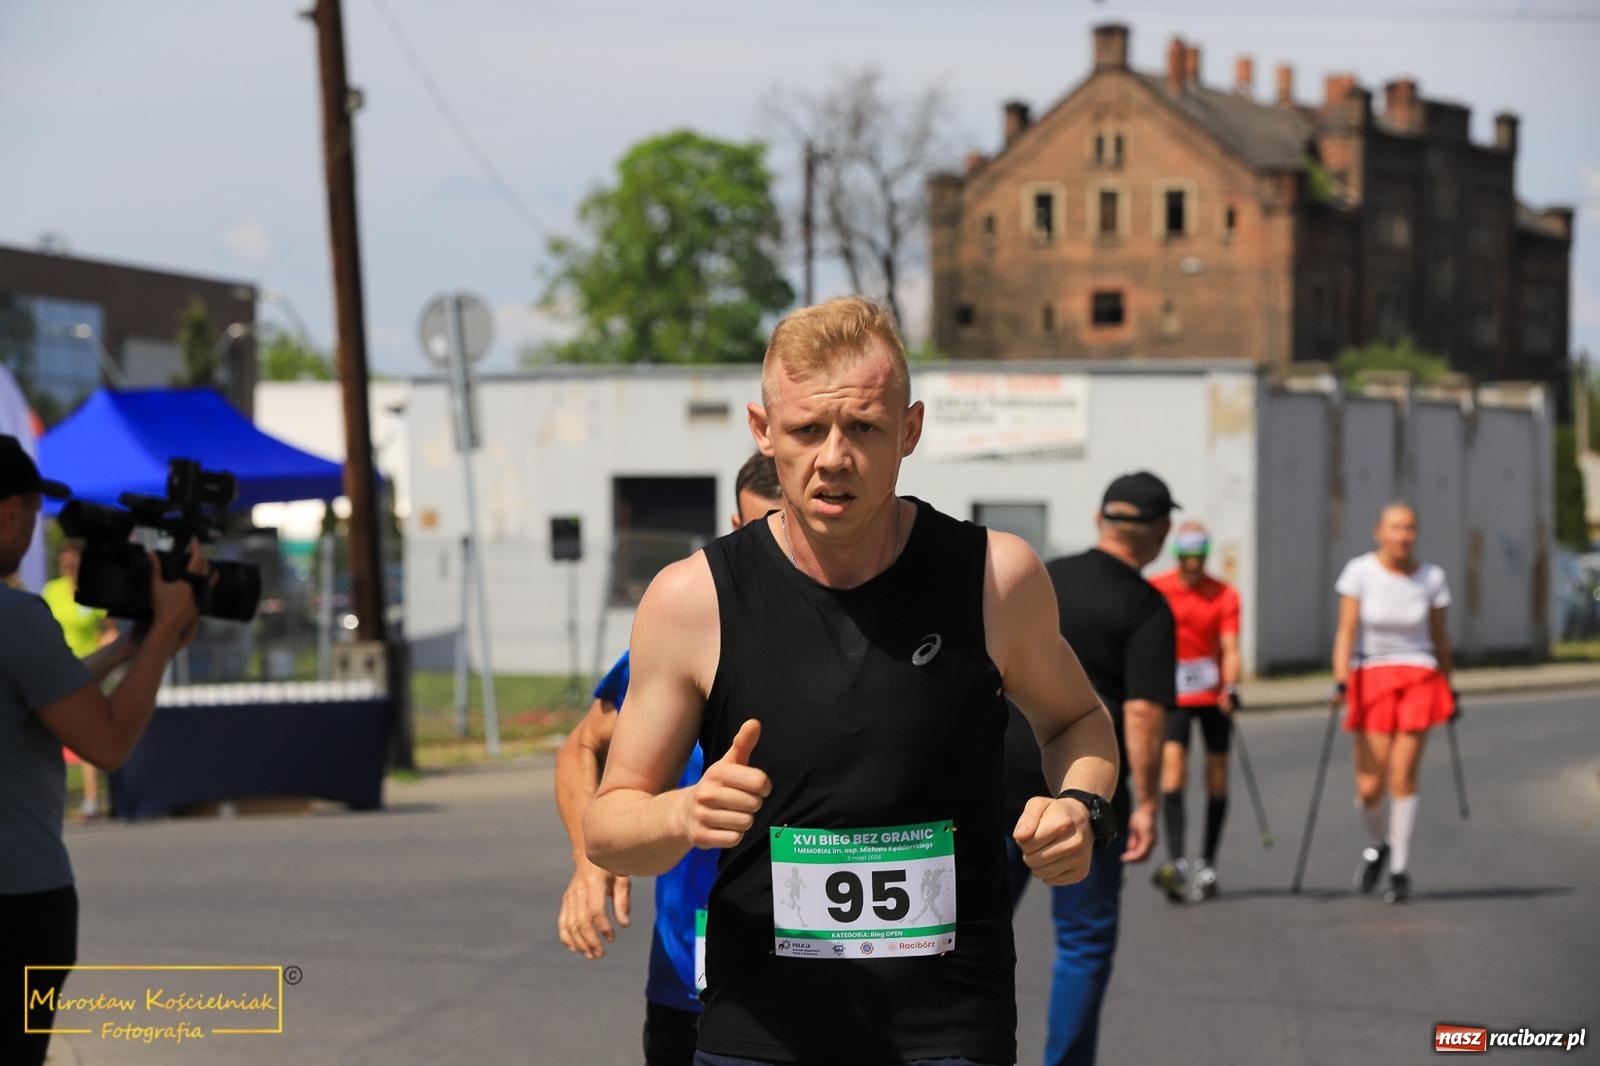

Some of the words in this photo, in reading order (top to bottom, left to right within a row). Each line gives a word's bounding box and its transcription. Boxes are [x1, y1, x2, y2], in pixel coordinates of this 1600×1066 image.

[793, 834, 816, 845] XVI
[819, 834, 850, 846] BIEG
[853, 833, 878, 845] BEZ
[881, 828, 934, 843] GRANIC
[825, 869, 910, 923] 95
[831, 931, 870, 939] KATEGORIA:
[871, 930, 885, 938] Bieg
[899, 941, 936, 950] Racibórz
